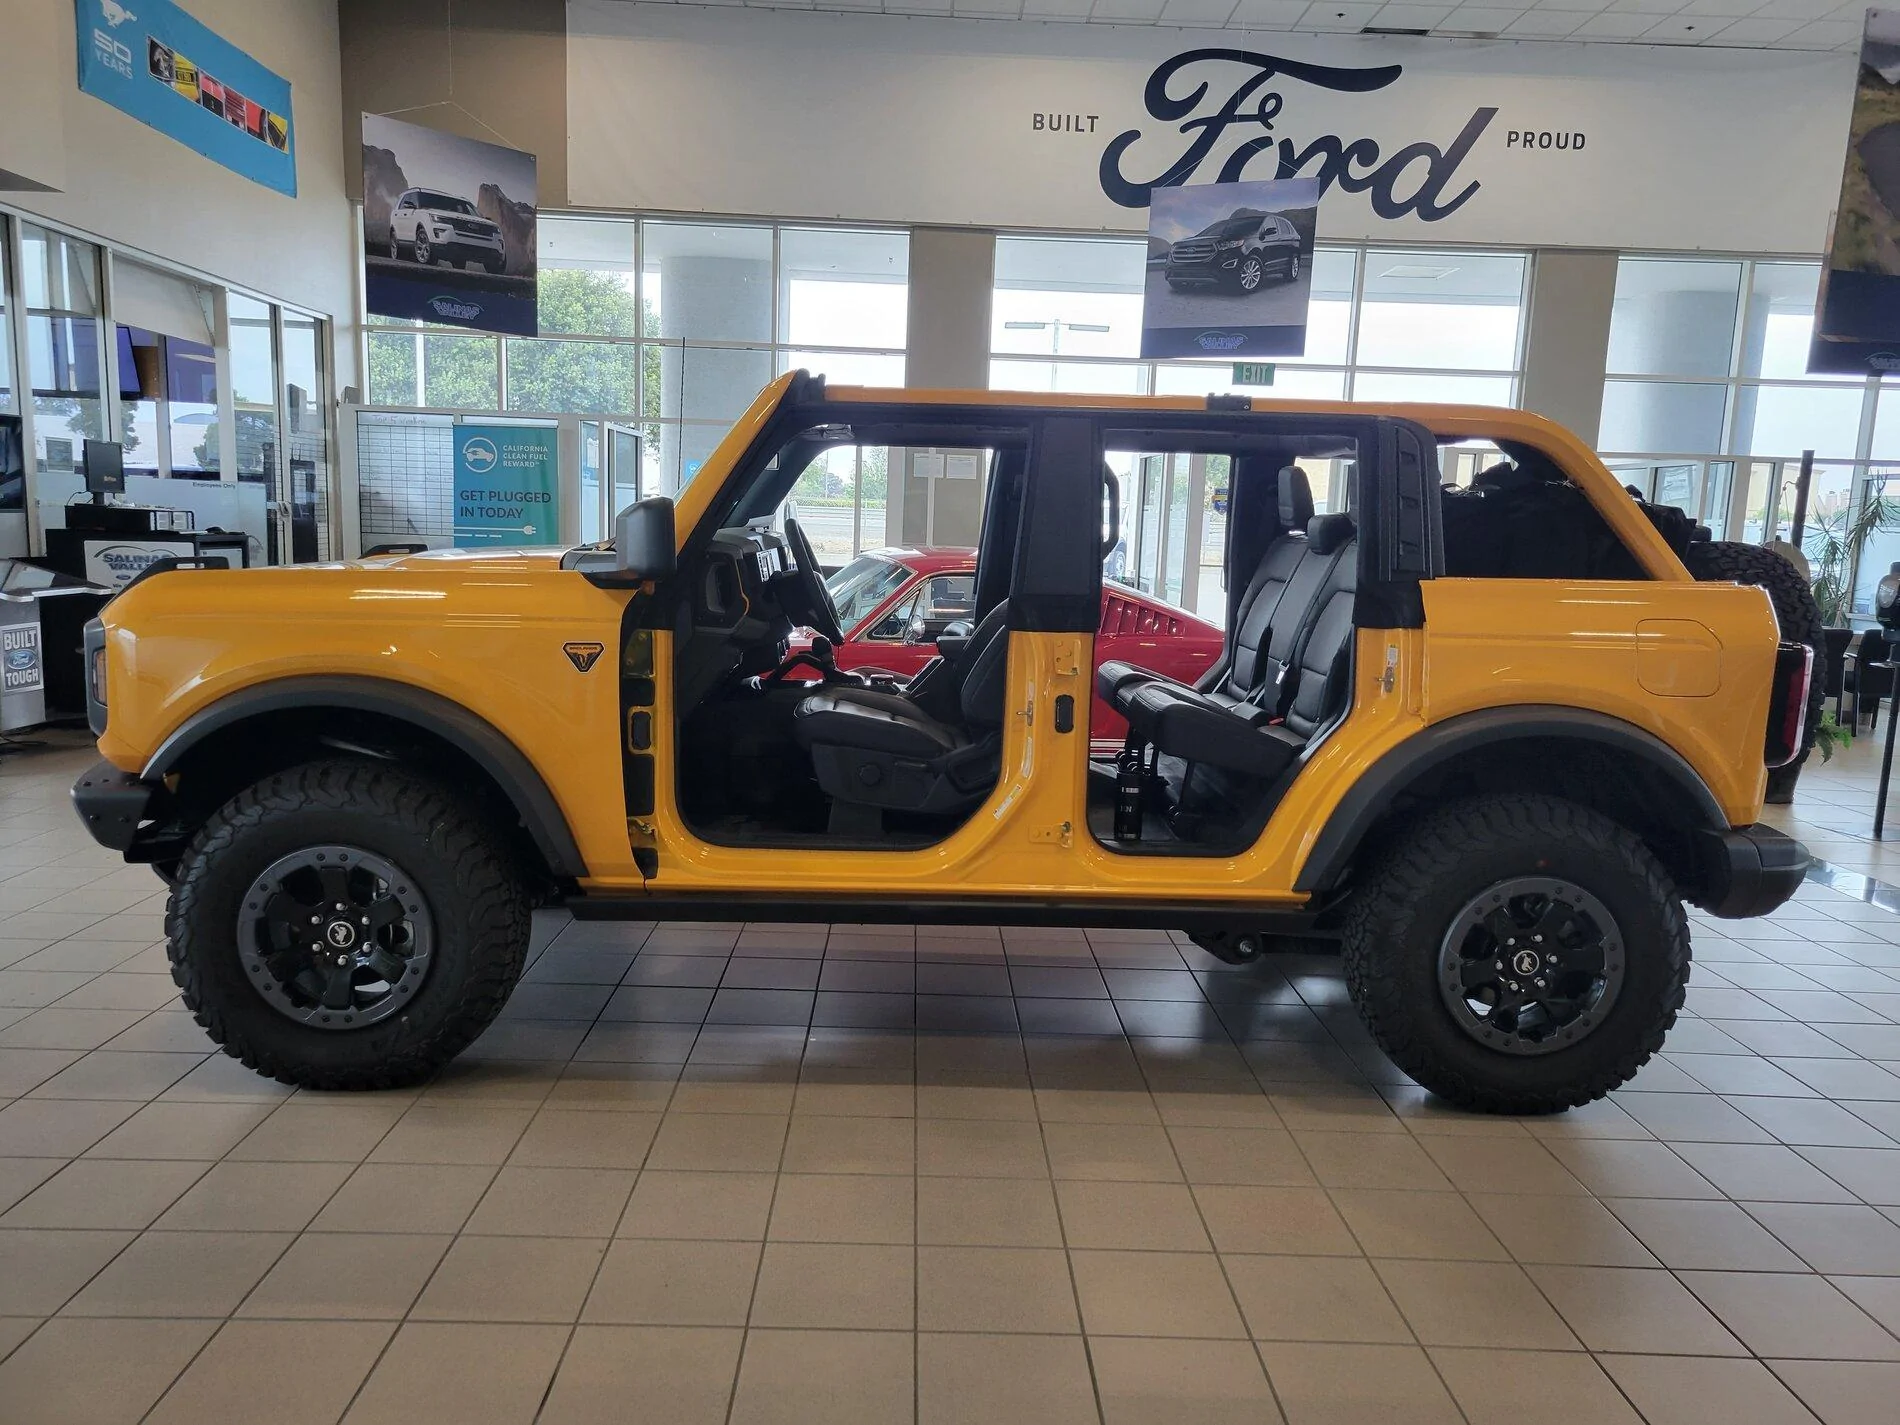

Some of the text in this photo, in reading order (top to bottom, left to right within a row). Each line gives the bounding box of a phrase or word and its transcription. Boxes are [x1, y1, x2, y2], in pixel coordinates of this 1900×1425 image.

[94, 28, 132, 64] 50
[95, 48, 133, 79] YEARS
[1033, 48, 1586, 223] BUILT Ford PROUD
[1243, 364, 1269, 383] EXIT
[460, 489, 551, 503] GET PLUGGED
[460, 506, 524, 518] IN TODAY
[3, 629, 37, 651] BUILT
[5, 668, 39, 687] TOUGH
